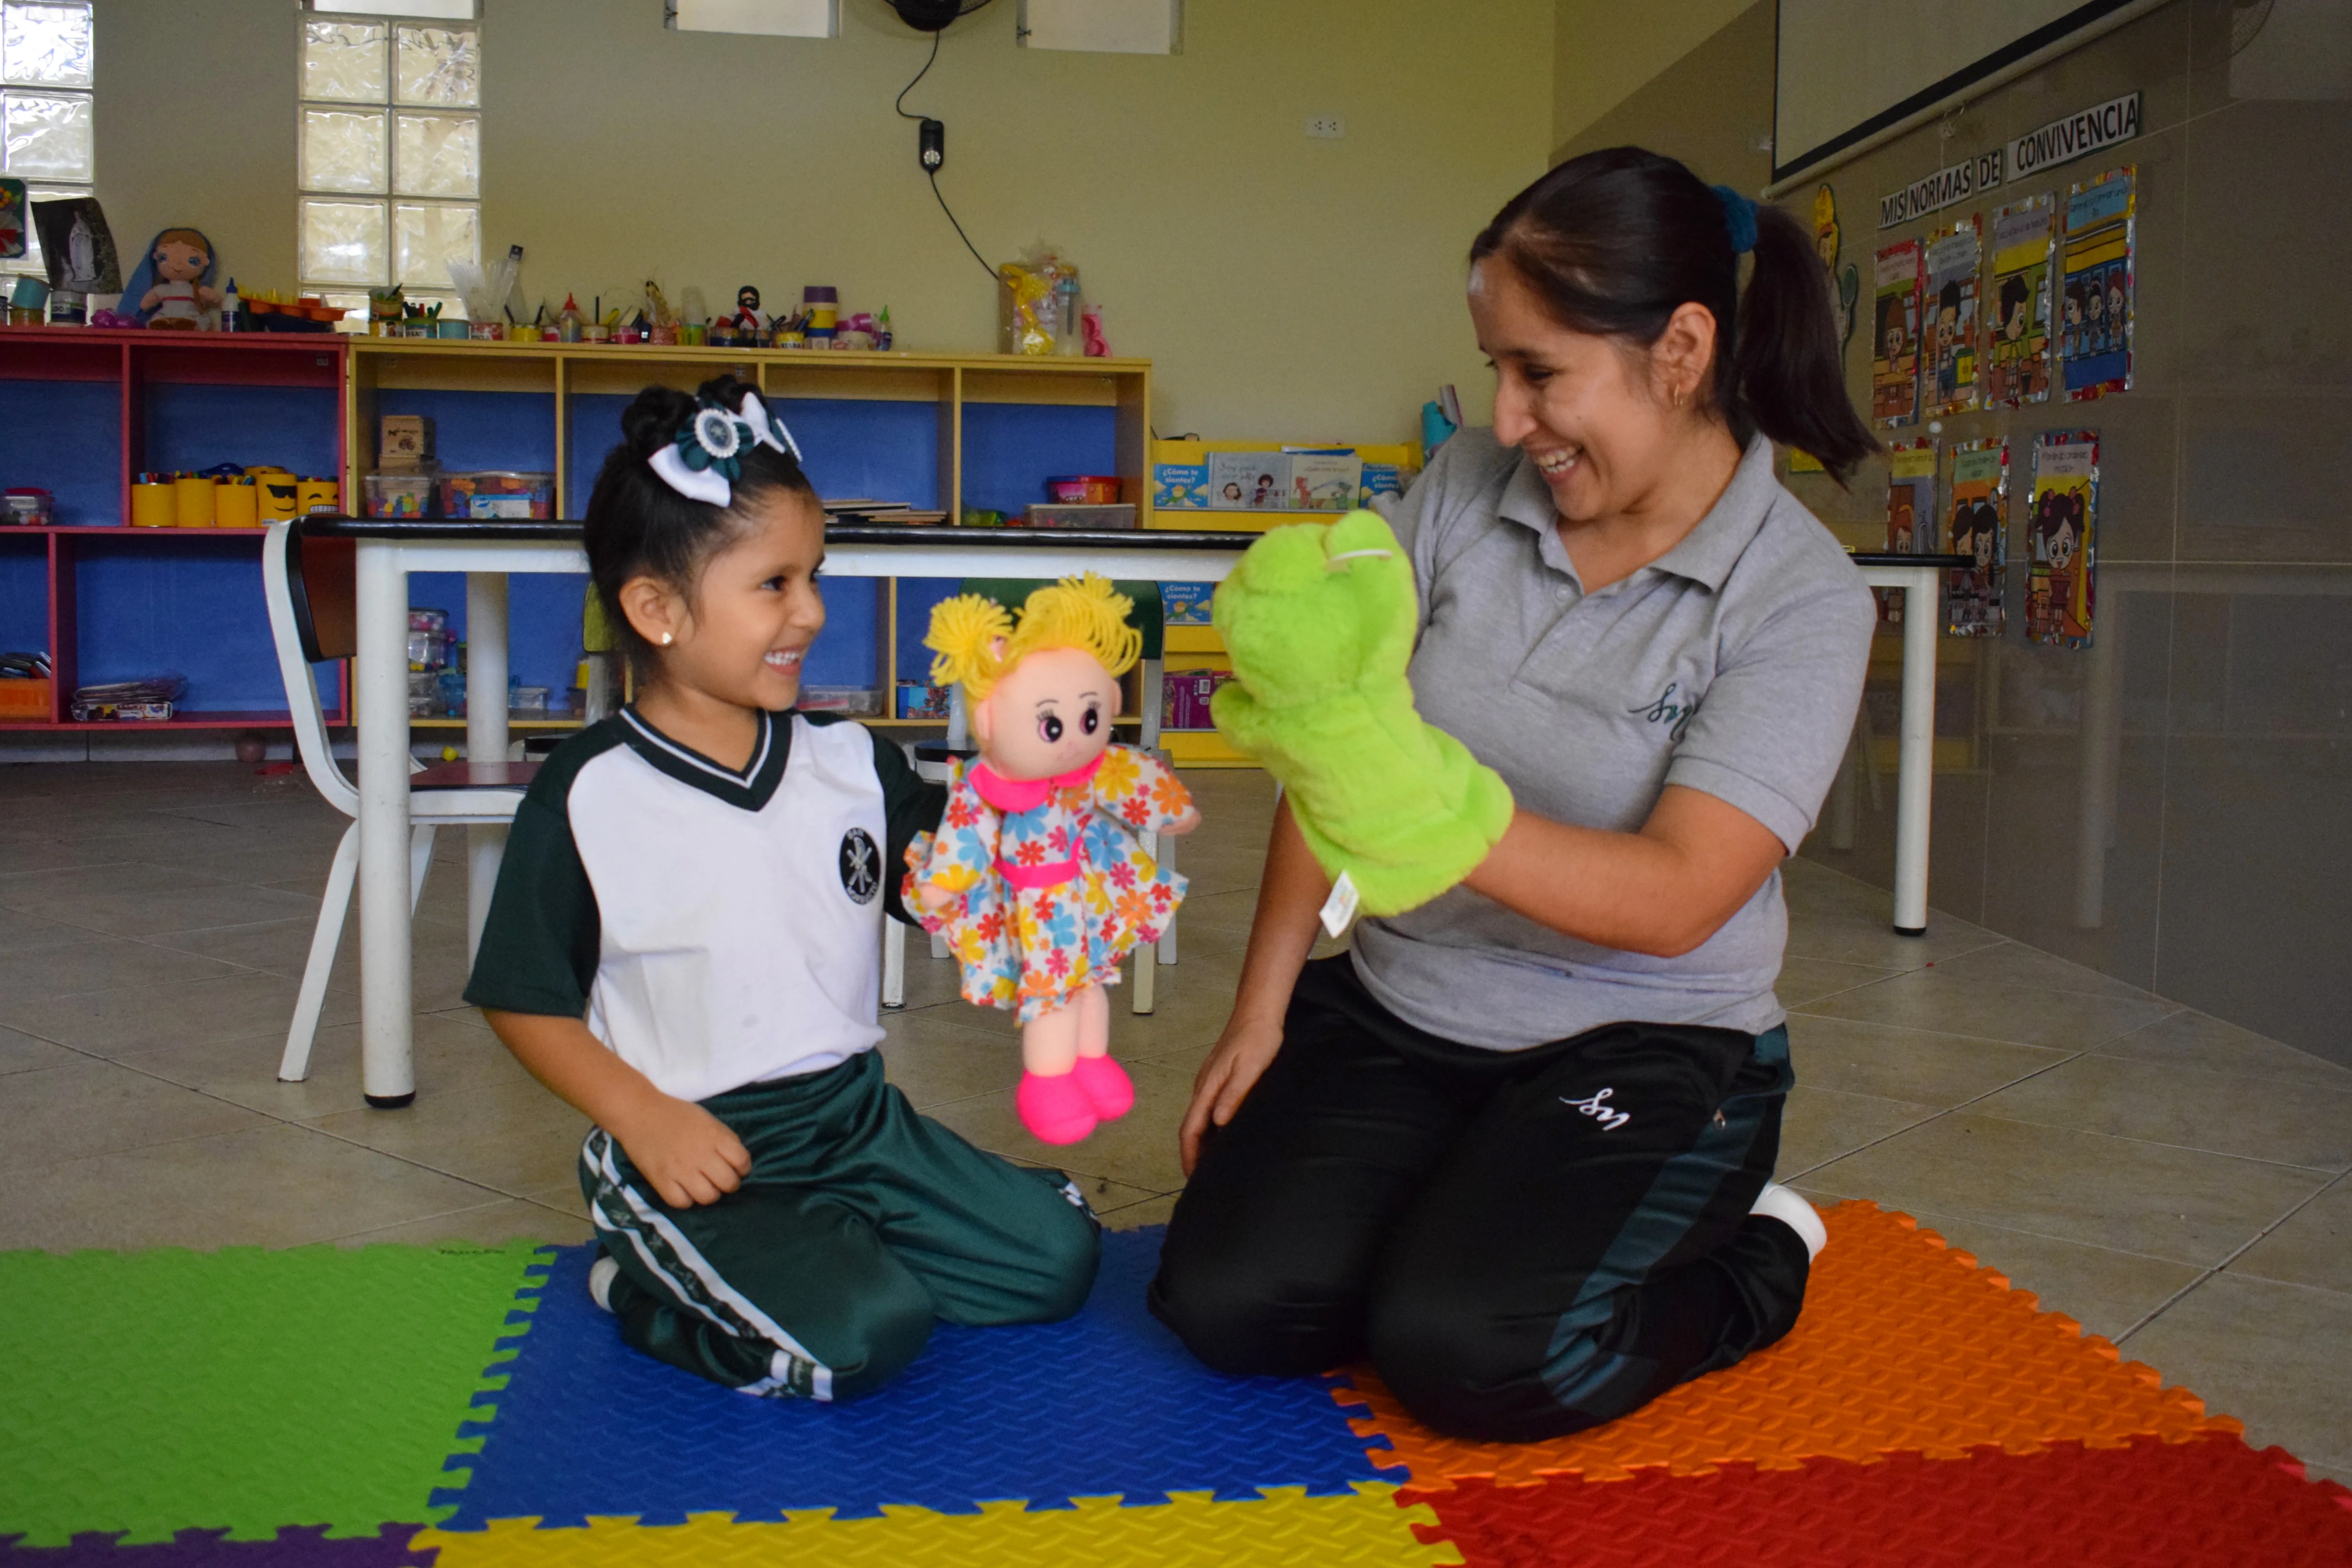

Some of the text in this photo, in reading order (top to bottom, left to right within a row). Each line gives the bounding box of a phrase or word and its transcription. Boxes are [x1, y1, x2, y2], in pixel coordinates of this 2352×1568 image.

[1880, 98, 2137, 226] MIS NORMAS DE CONVIVENCIA
